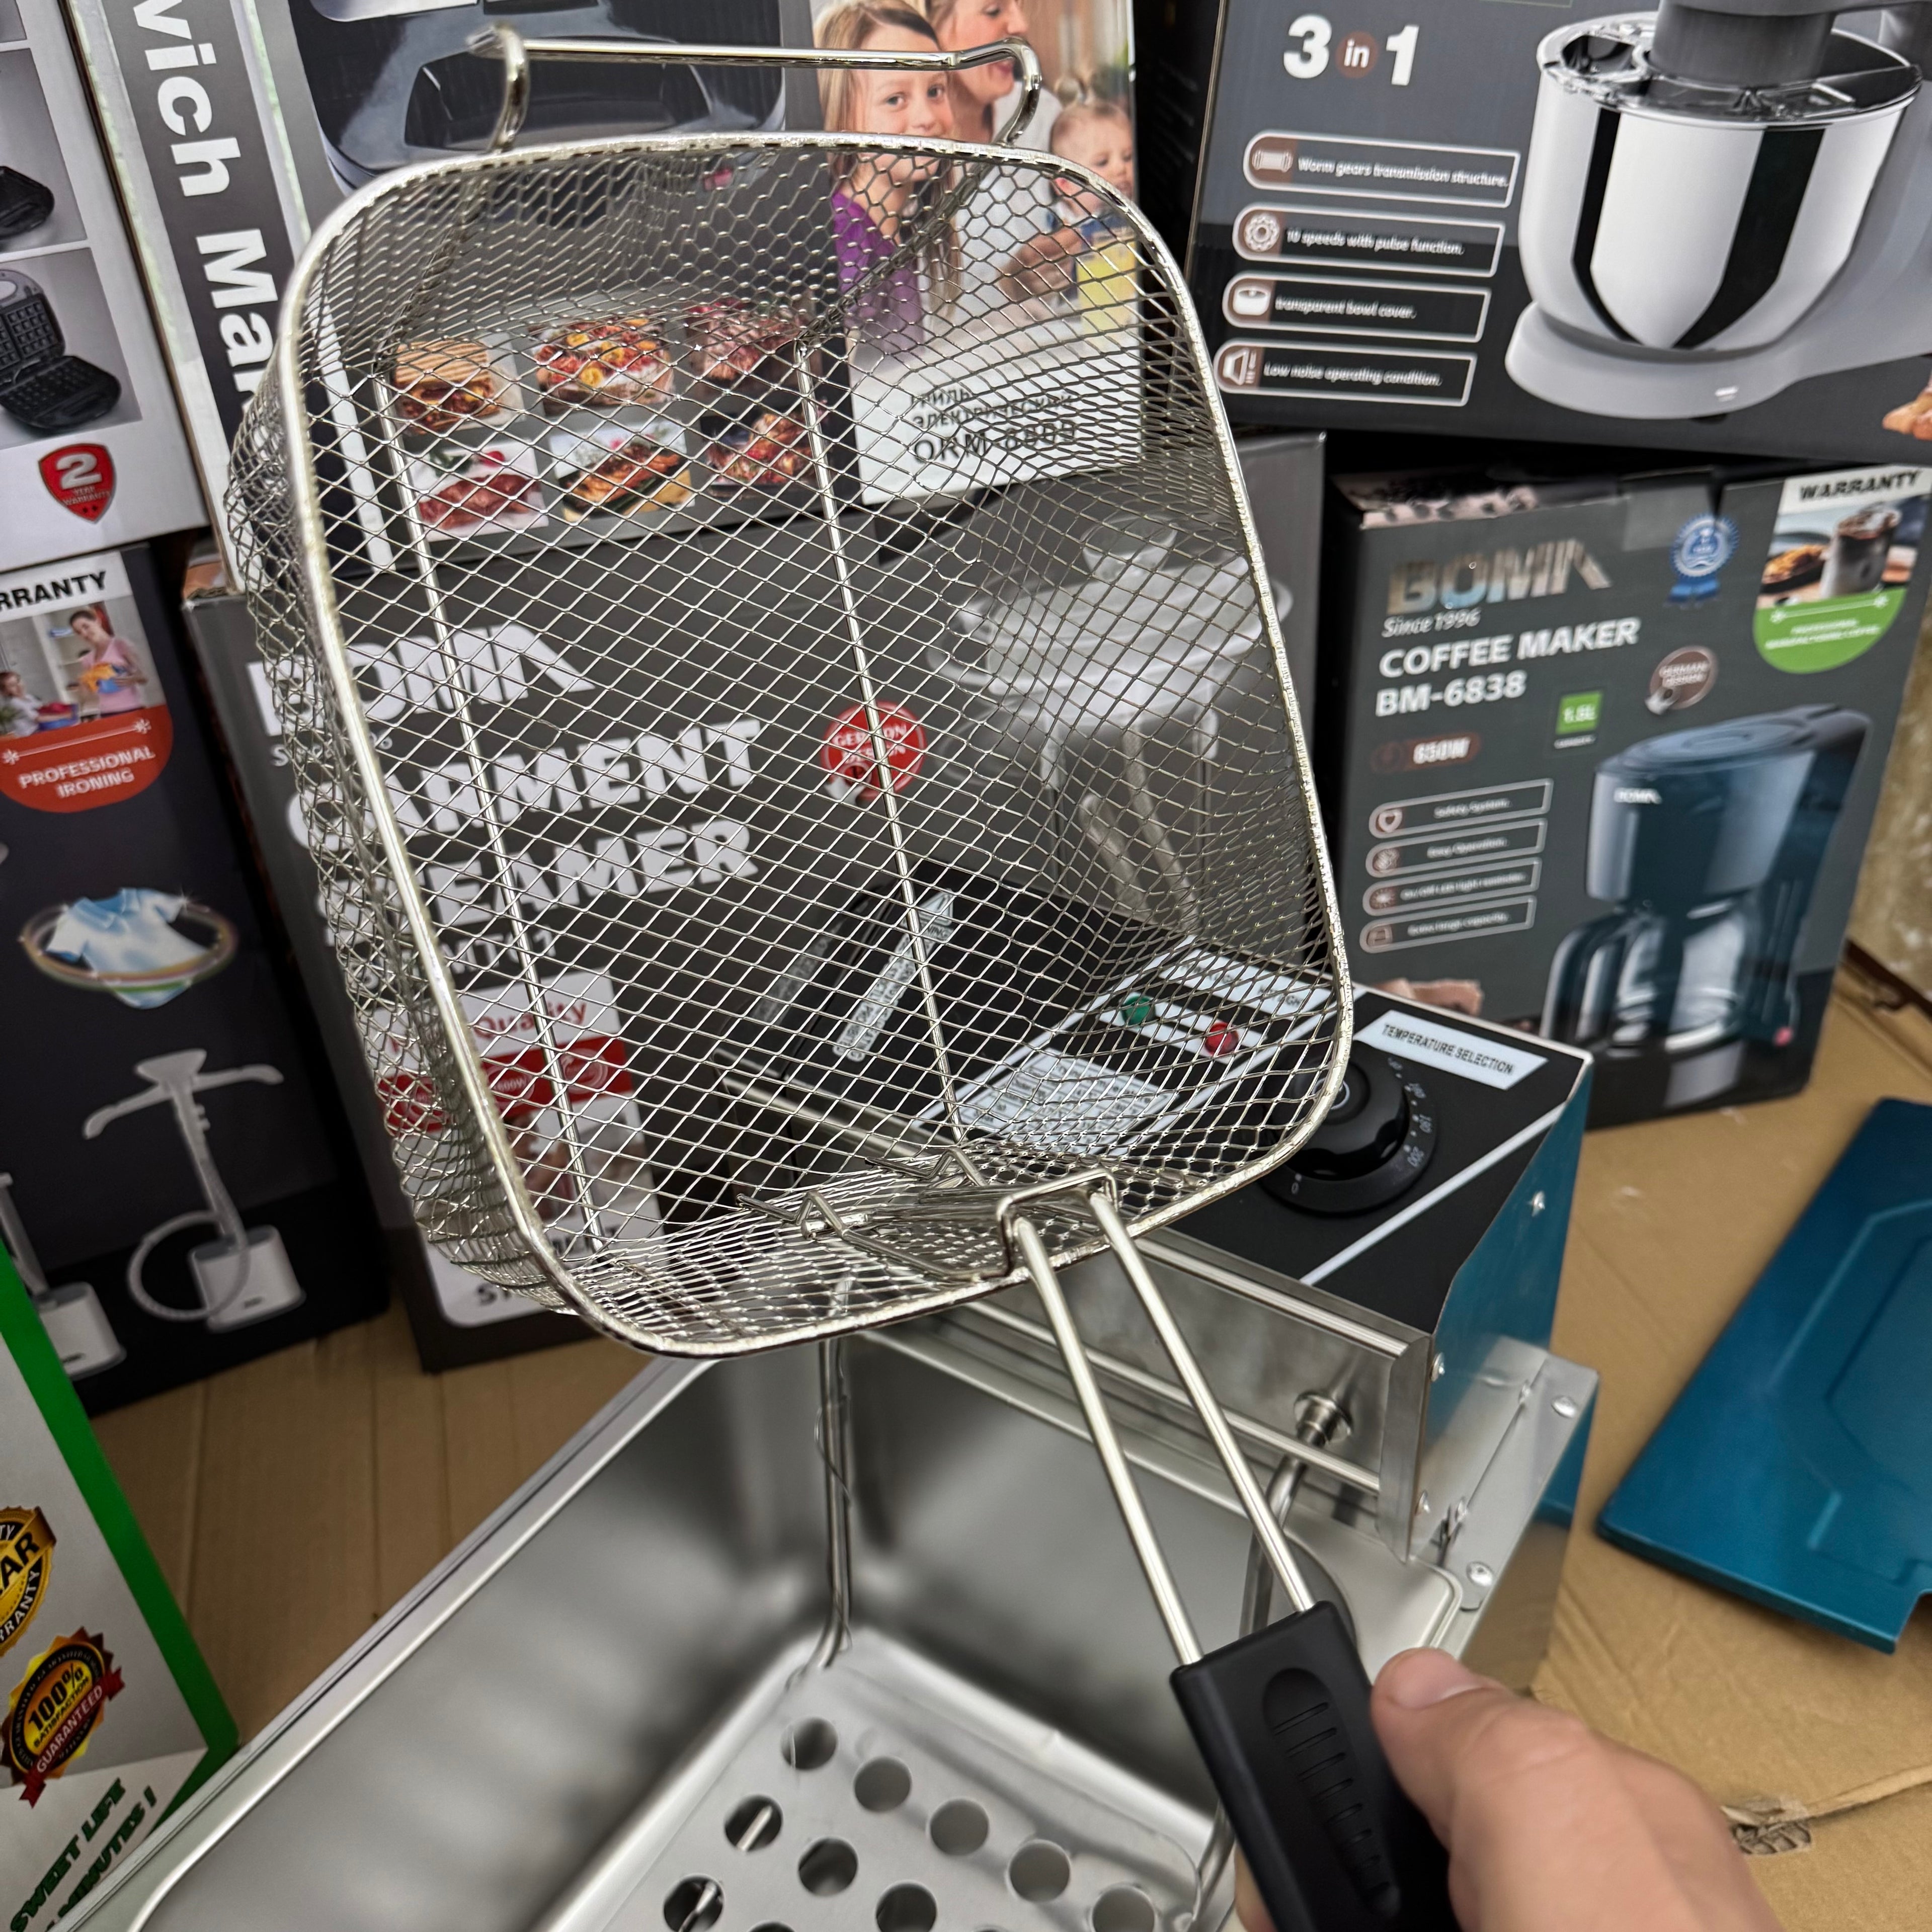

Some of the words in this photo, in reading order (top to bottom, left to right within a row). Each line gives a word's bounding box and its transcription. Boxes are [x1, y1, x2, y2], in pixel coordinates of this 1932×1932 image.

[1283, 15, 1332, 78] 3
[1343, 40, 1370, 68] in
[1386, 24, 1419, 86] 1
[1298, 157, 1334, 173] Worm
[1336, 161, 1372, 177] gears
[1373, 163, 1450, 183] transmission
[1451, 170, 1509, 188] structure.
[1302, 229, 1346, 247] speeds
[1347, 234, 1375, 249] with
[1375, 236, 1410, 252] pulse
[1346, 299, 1379, 316] bowl
[1263, 361, 1290, 378] Low
[1290, 363, 1325, 379] noise
[1324, 366, 1384, 385] operating
[1384, 369, 1443, 387] condition.
[56, 452, 103, 490] 2
[1799, 469, 1922, 501] WARRANTY
[1379, 634, 1513, 678] COFFEE
[1516, 616, 1642, 660] MAKER
[1381, 613, 1433, 638] Since
[1375, 669, 1528, 717] BM-6838
[18, 746, 156, 789] PROFESSIONAL
[56, 768, 135, 799] IRONING
[315, 819, 760, 928] SEAMER
[473, 1001, 588, 1038] Quaity
[1382, 1024, 1456, 1057] TEMPERATURE
[1455, 1046, 1515, 1075] SELECTION
[28, 1662, 85, 1731] 100%
[33, 1675, 90, 1748] SATISFACTION
[37, 1684, 103, 1773] GUARANTEED
[10, 1834, 81, 1932] SWEET
[82, 1777, 126, 1842] LIFE
